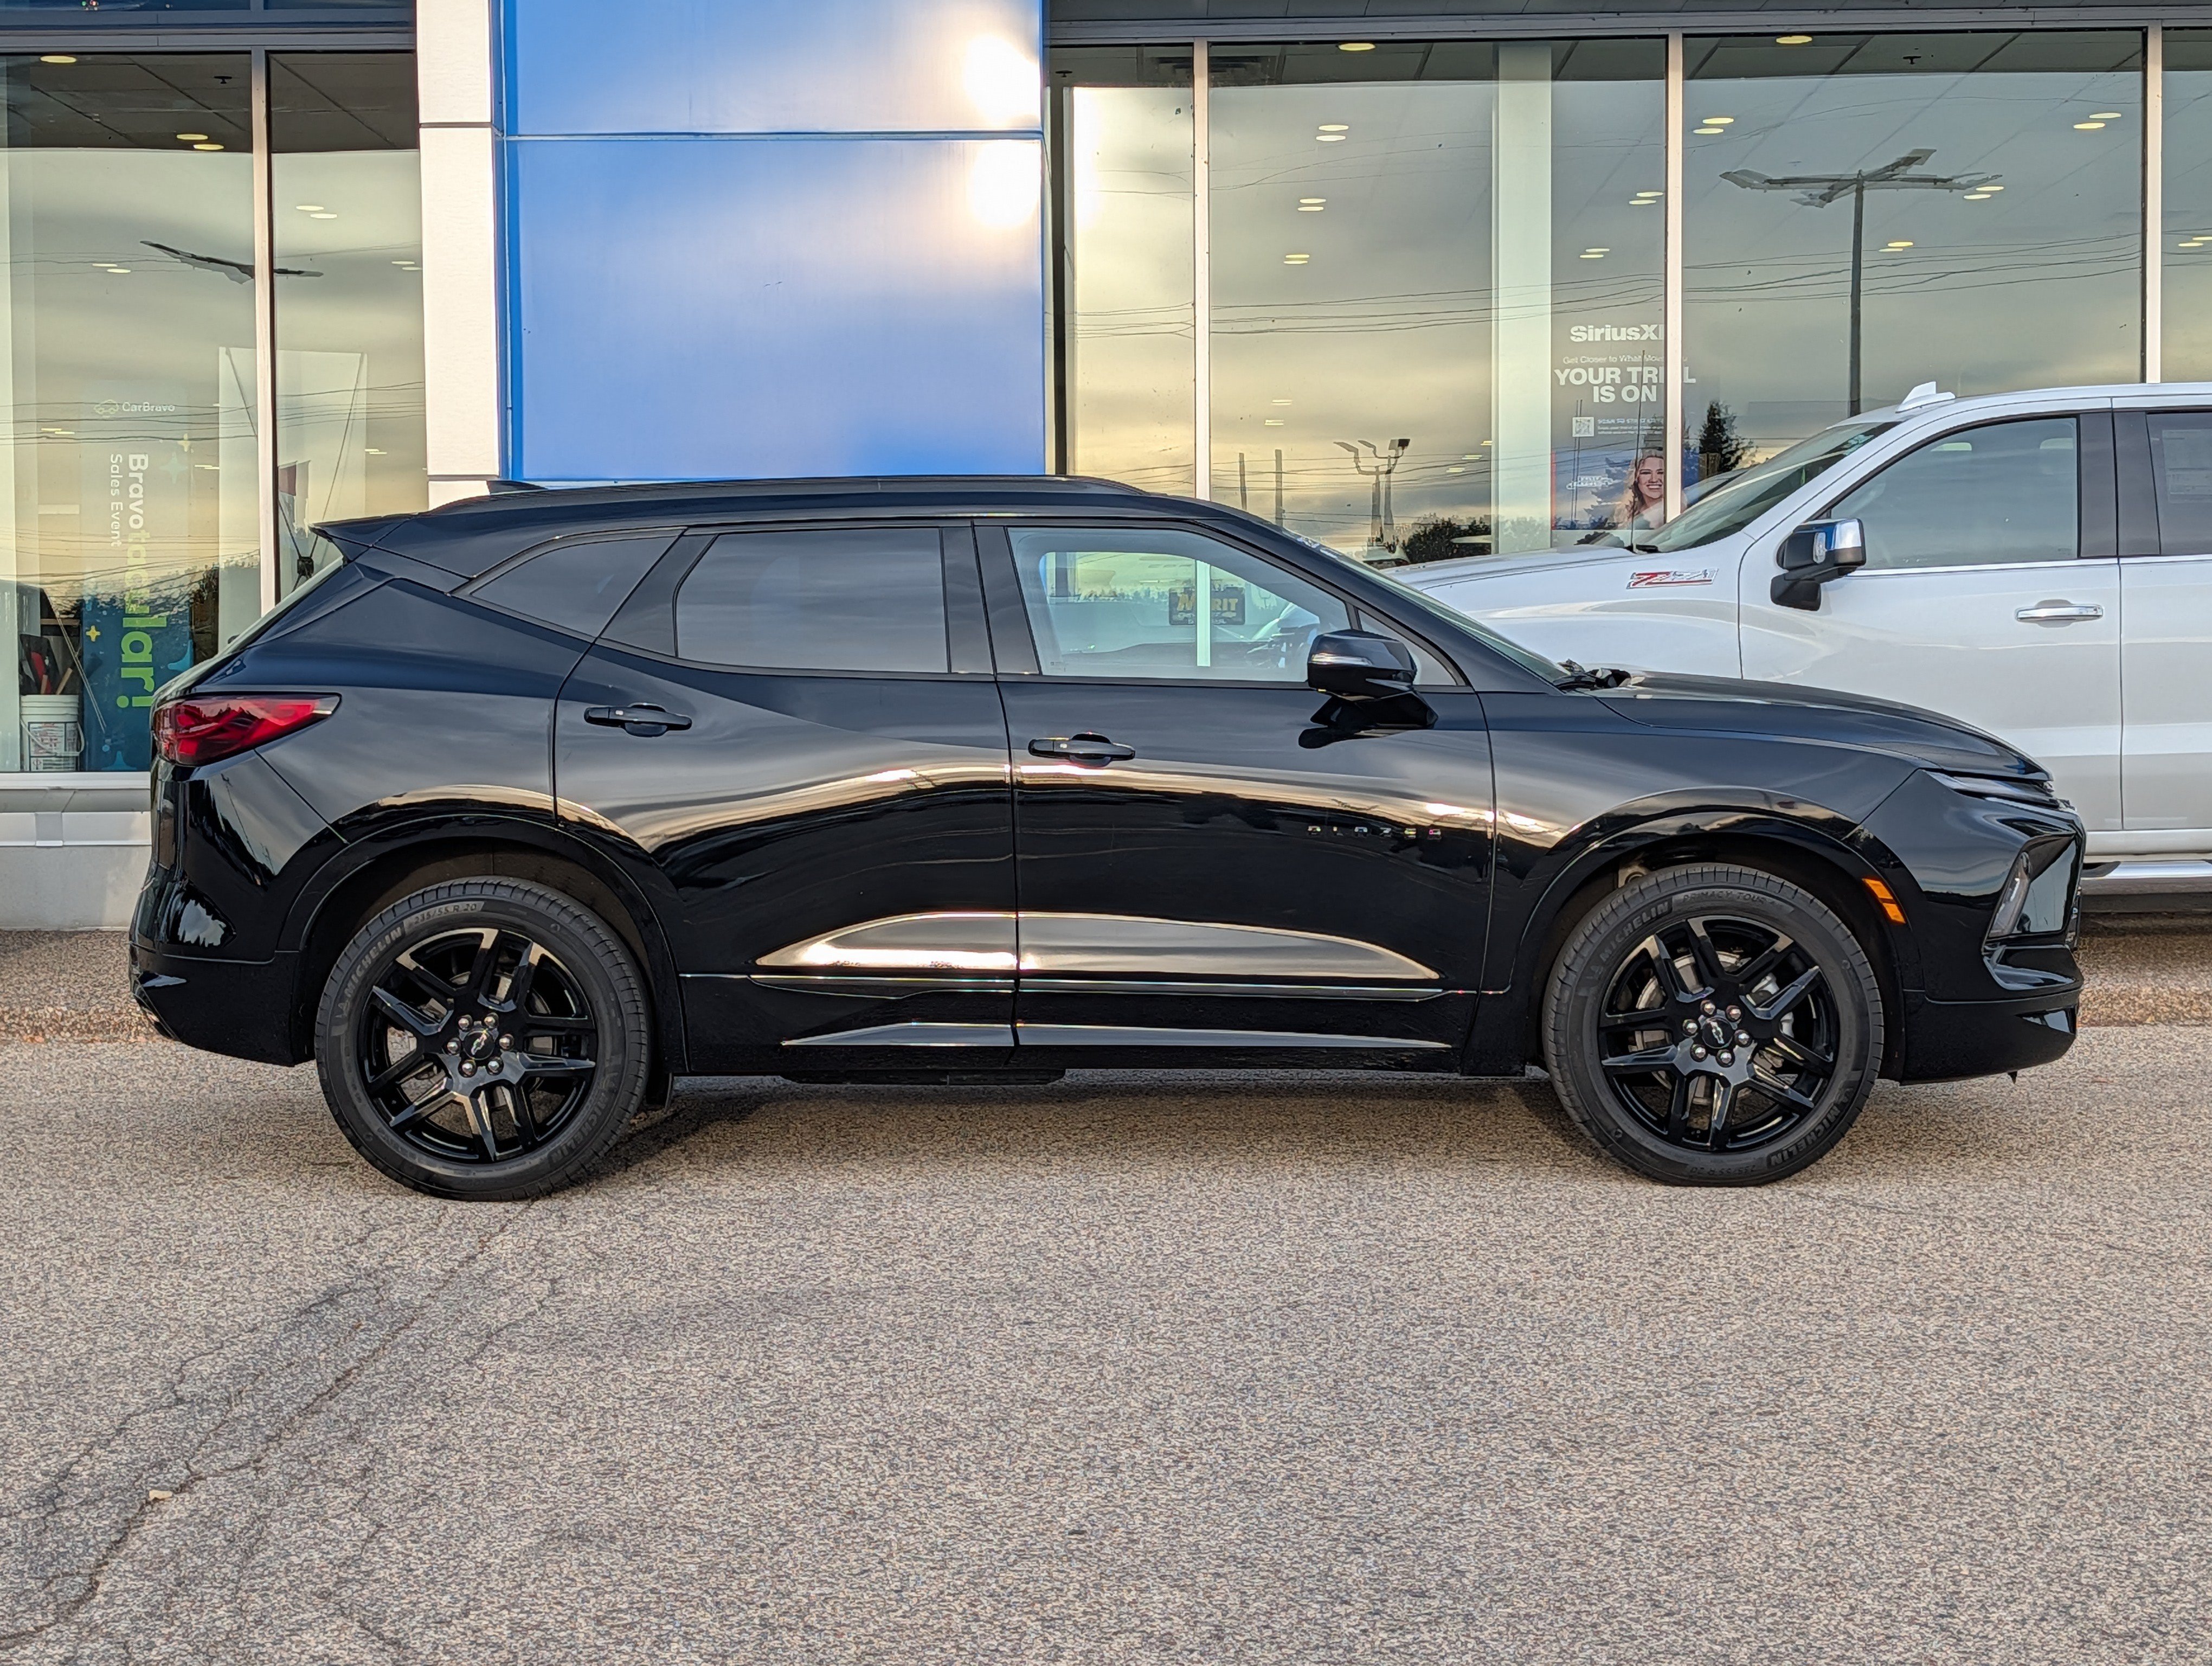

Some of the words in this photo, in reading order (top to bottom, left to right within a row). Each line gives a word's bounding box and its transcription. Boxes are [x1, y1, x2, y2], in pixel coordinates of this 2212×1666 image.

[1609, 355, 1617, 363] to
[1554, 366, 1621, 386] YOUR
[1626, 366, 1696, 384] TRIL
[1593, 386, 1616, 403] IS
[1621, 385, 1657, 402] ON
[122, 401, 175, 412] CarBravo
[110, 453, 123, 496] Sales
[110, 502, 123, 548] Event
[1176, 593, 1238, 611] MRIT
[453, 905, 460, 913] R
[1599, 900, 1669, 962] MICHELIN
[344, 926, 402, 998] MICHELIN
[1770, 1105, 1841, 1166] MICHELIN
